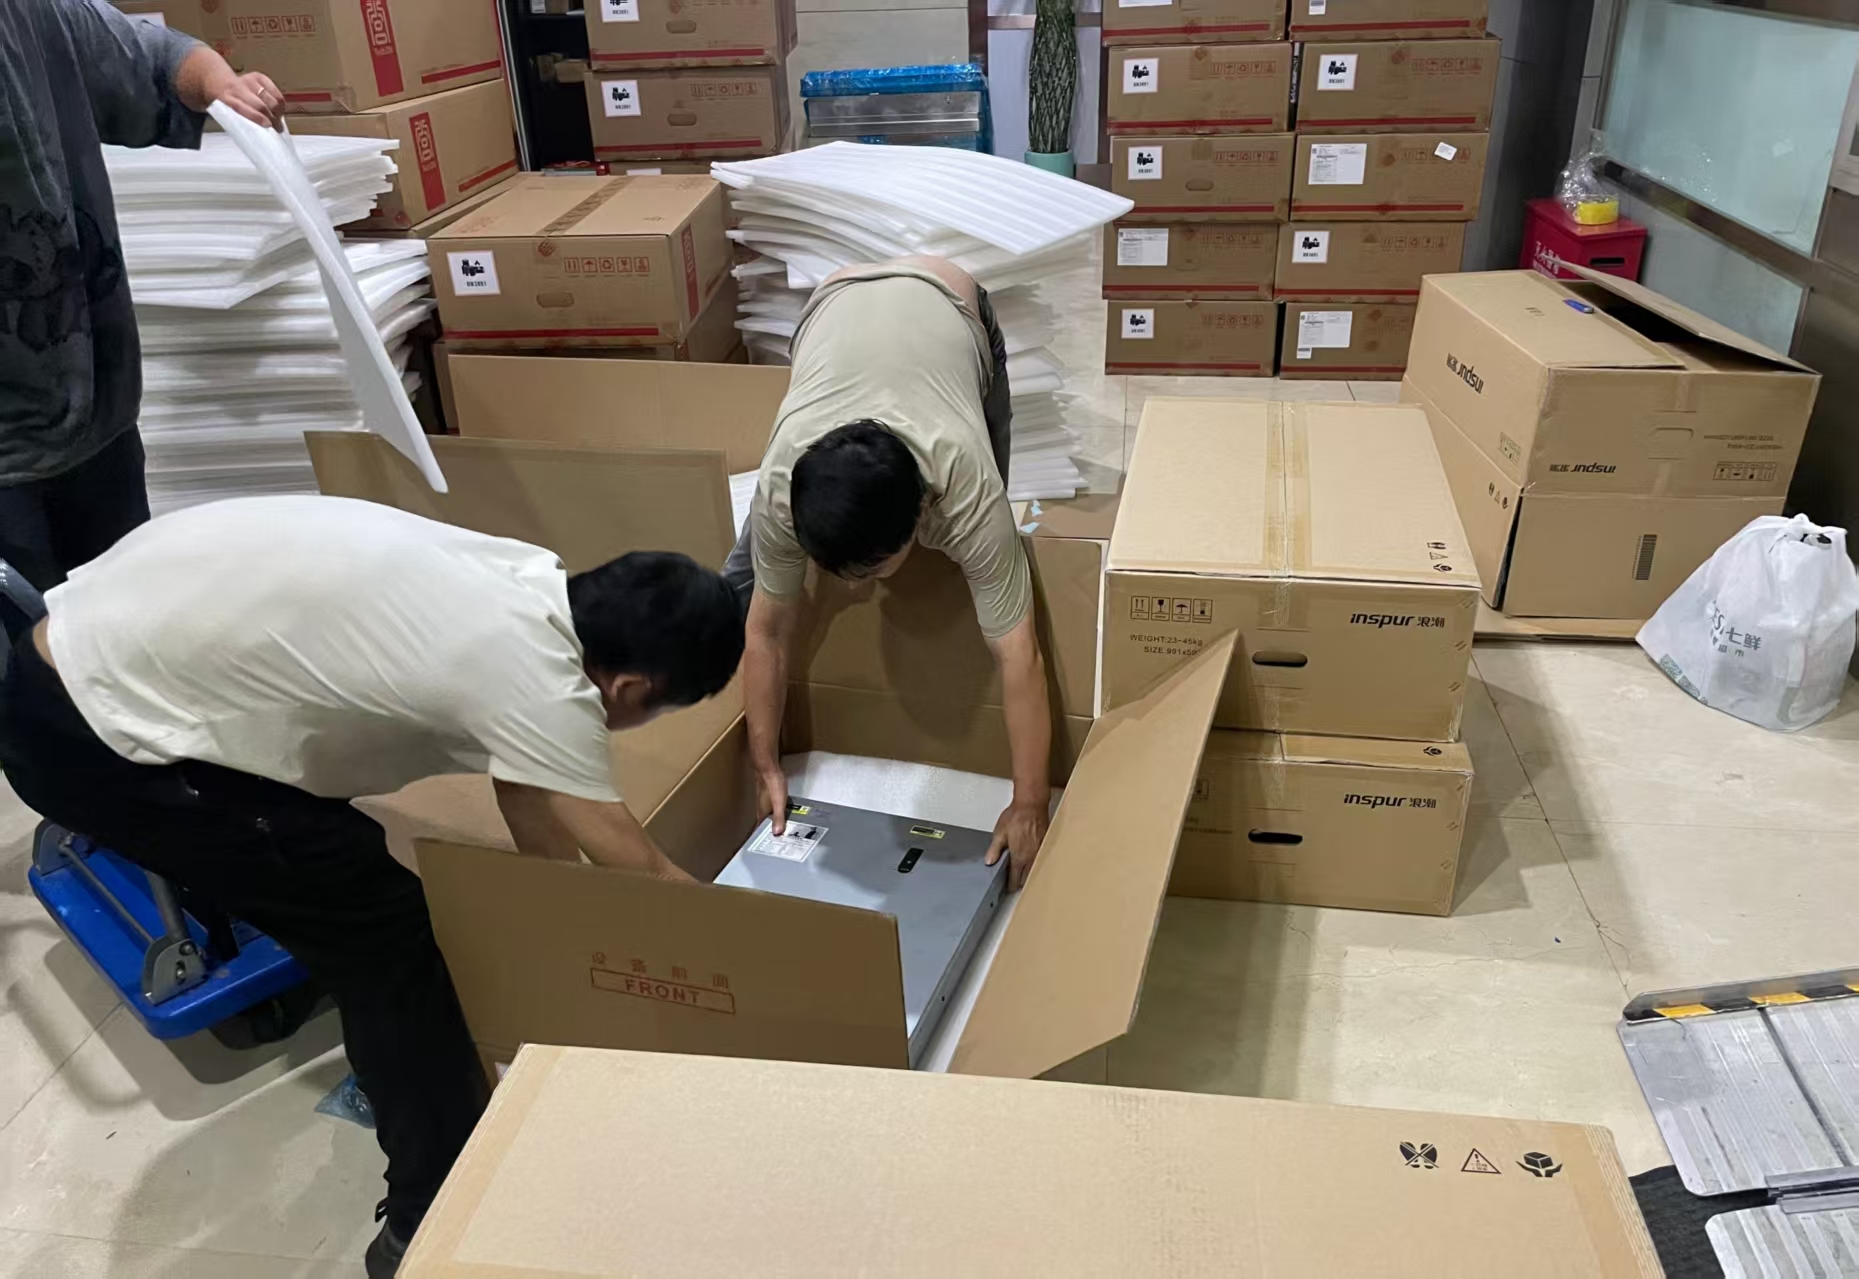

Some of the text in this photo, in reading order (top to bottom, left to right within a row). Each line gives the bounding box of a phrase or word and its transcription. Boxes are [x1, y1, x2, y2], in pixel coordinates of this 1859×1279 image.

[1570, 462, 1616, 473] inspur
[1350, 613, 1446, 628] inspur 浪潮
[1725, 627, 1761, 651] 七鲜
[1344, 794, 1437, 809] inspur 浪潮
[625, 979, 700, 1004] FRONT
